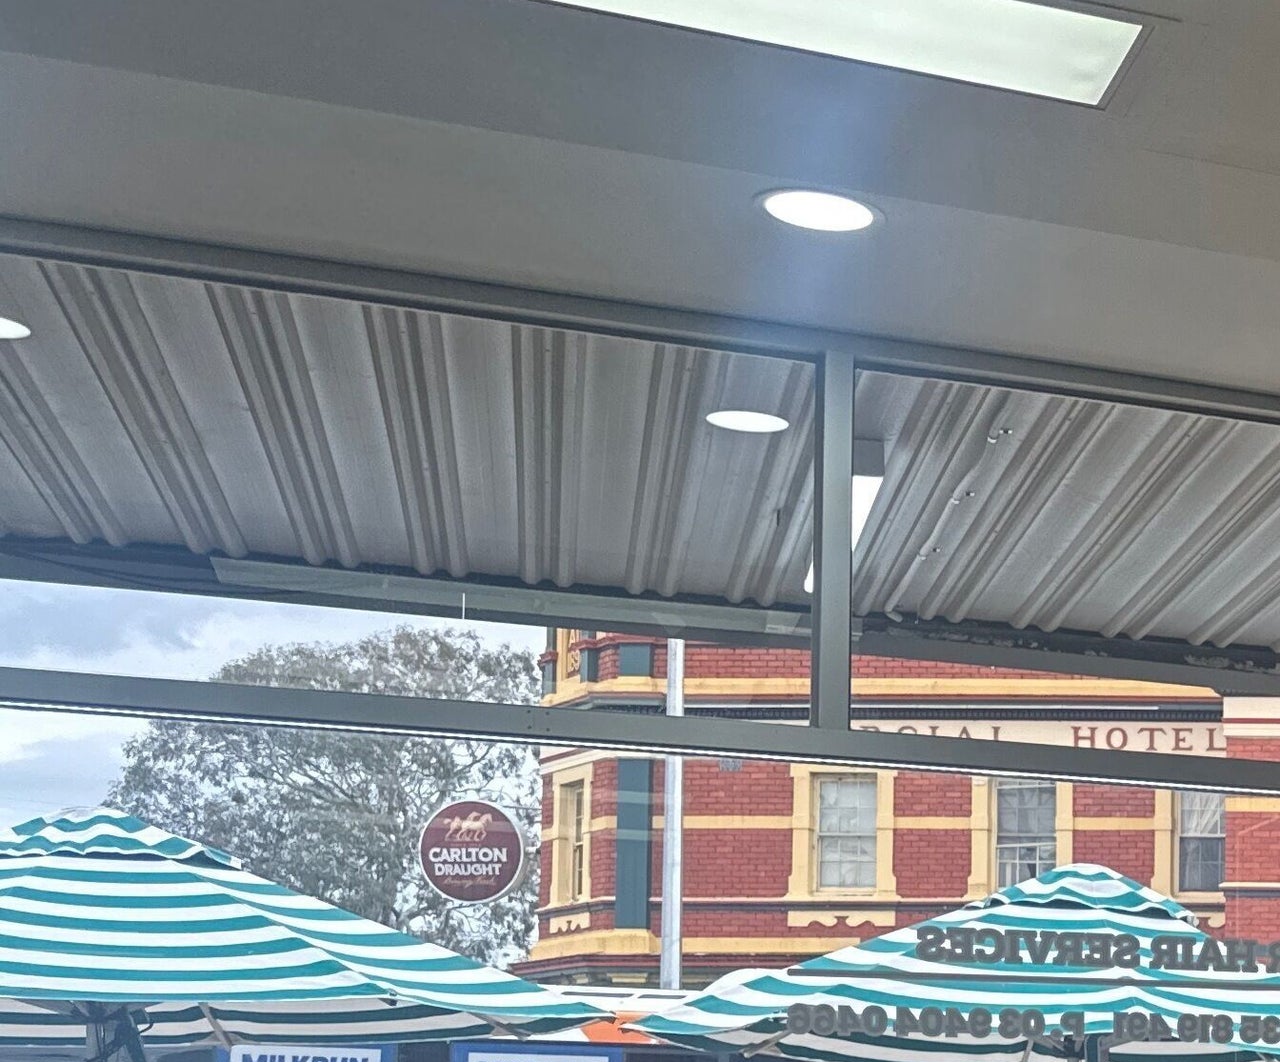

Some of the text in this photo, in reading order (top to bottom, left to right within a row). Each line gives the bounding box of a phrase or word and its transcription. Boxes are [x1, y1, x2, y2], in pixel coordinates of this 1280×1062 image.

[1070, 725, 1227, 752] HOTEL
[428, 846, 508, 863] CARLTON
[434, 863, 502, 878] DRAUGHT
